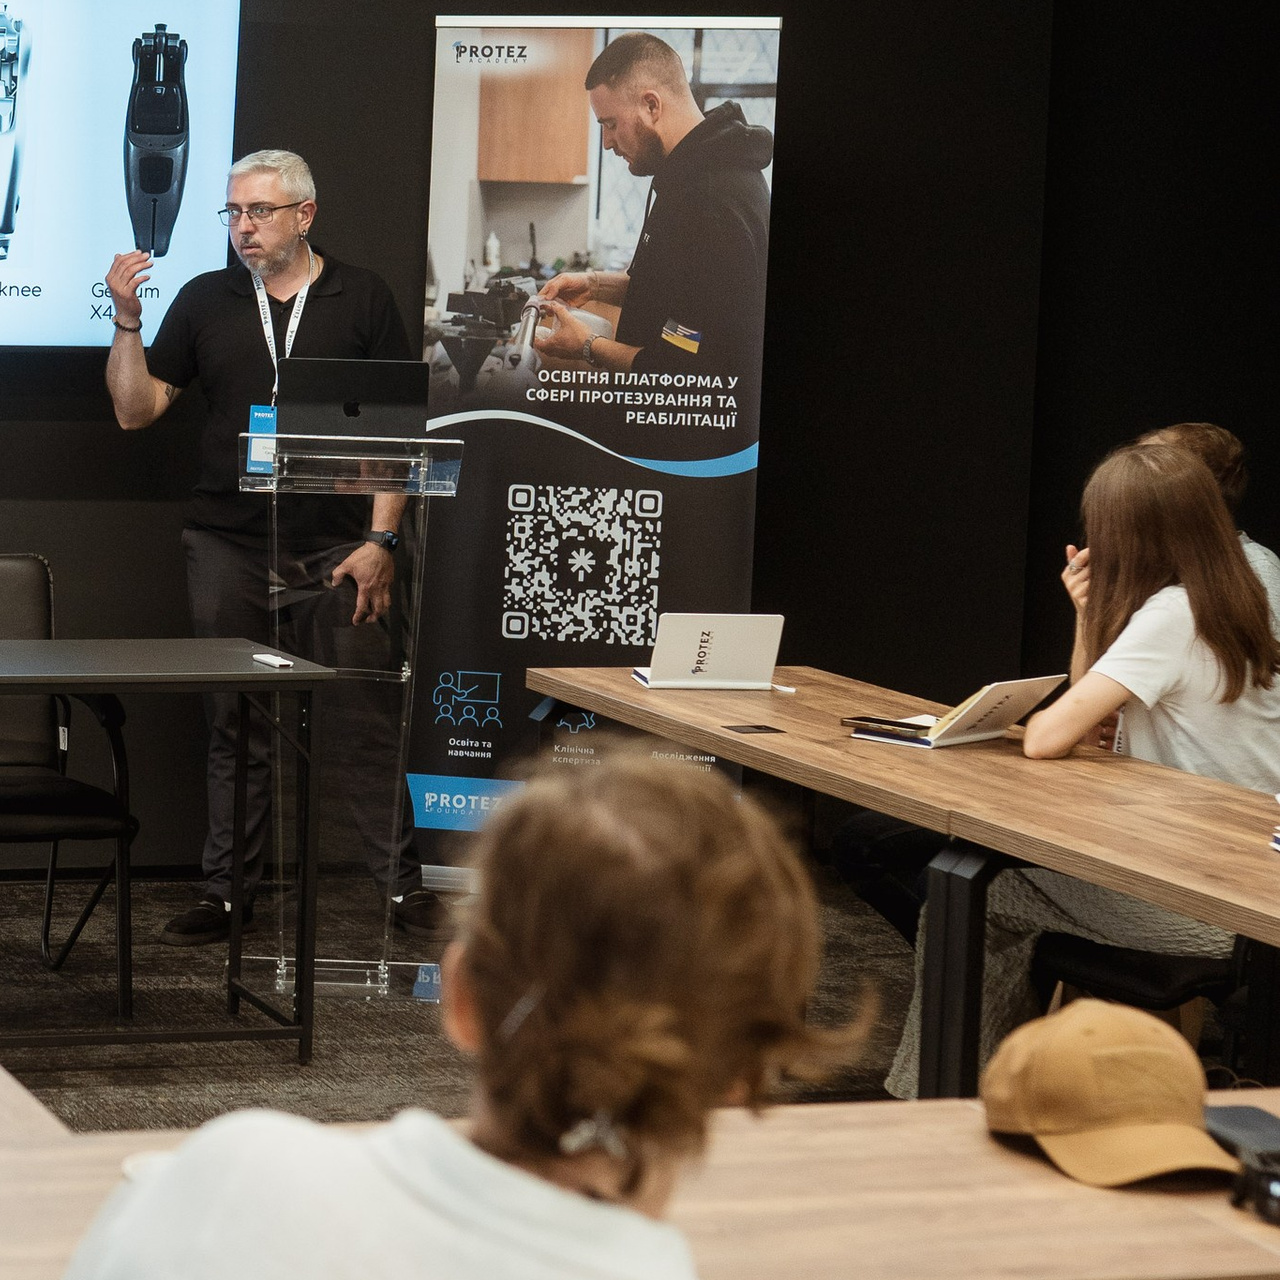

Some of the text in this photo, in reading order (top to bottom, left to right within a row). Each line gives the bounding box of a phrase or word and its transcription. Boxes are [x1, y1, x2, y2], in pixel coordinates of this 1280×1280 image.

[459, 45, 527, 58] PROTEZ
[91, 282, 160, 299] Geum
[538, 370, 609, 384] ОСВІТНЯ
[614, 372, 723, 389] ПЛАТФОРМА
[526, 388, 737, 408] СФЕРІ ПРОТЕЗУВАННЯ ТА
[626, 411, 738, 430] РЕАБІЛІТАЦІЇ
[695, 631, 711, 673] PROTEZ
[448, 737, 479, 748] Освіта
[448, 749, 492, 759] навчання
[554, 744, 595, 755] Клінічна
[552, 756, 601, 766] кспертиза
[651, 751, 716, 763] Дослідження
[429, 807, 487, 816] FOUNDATI
